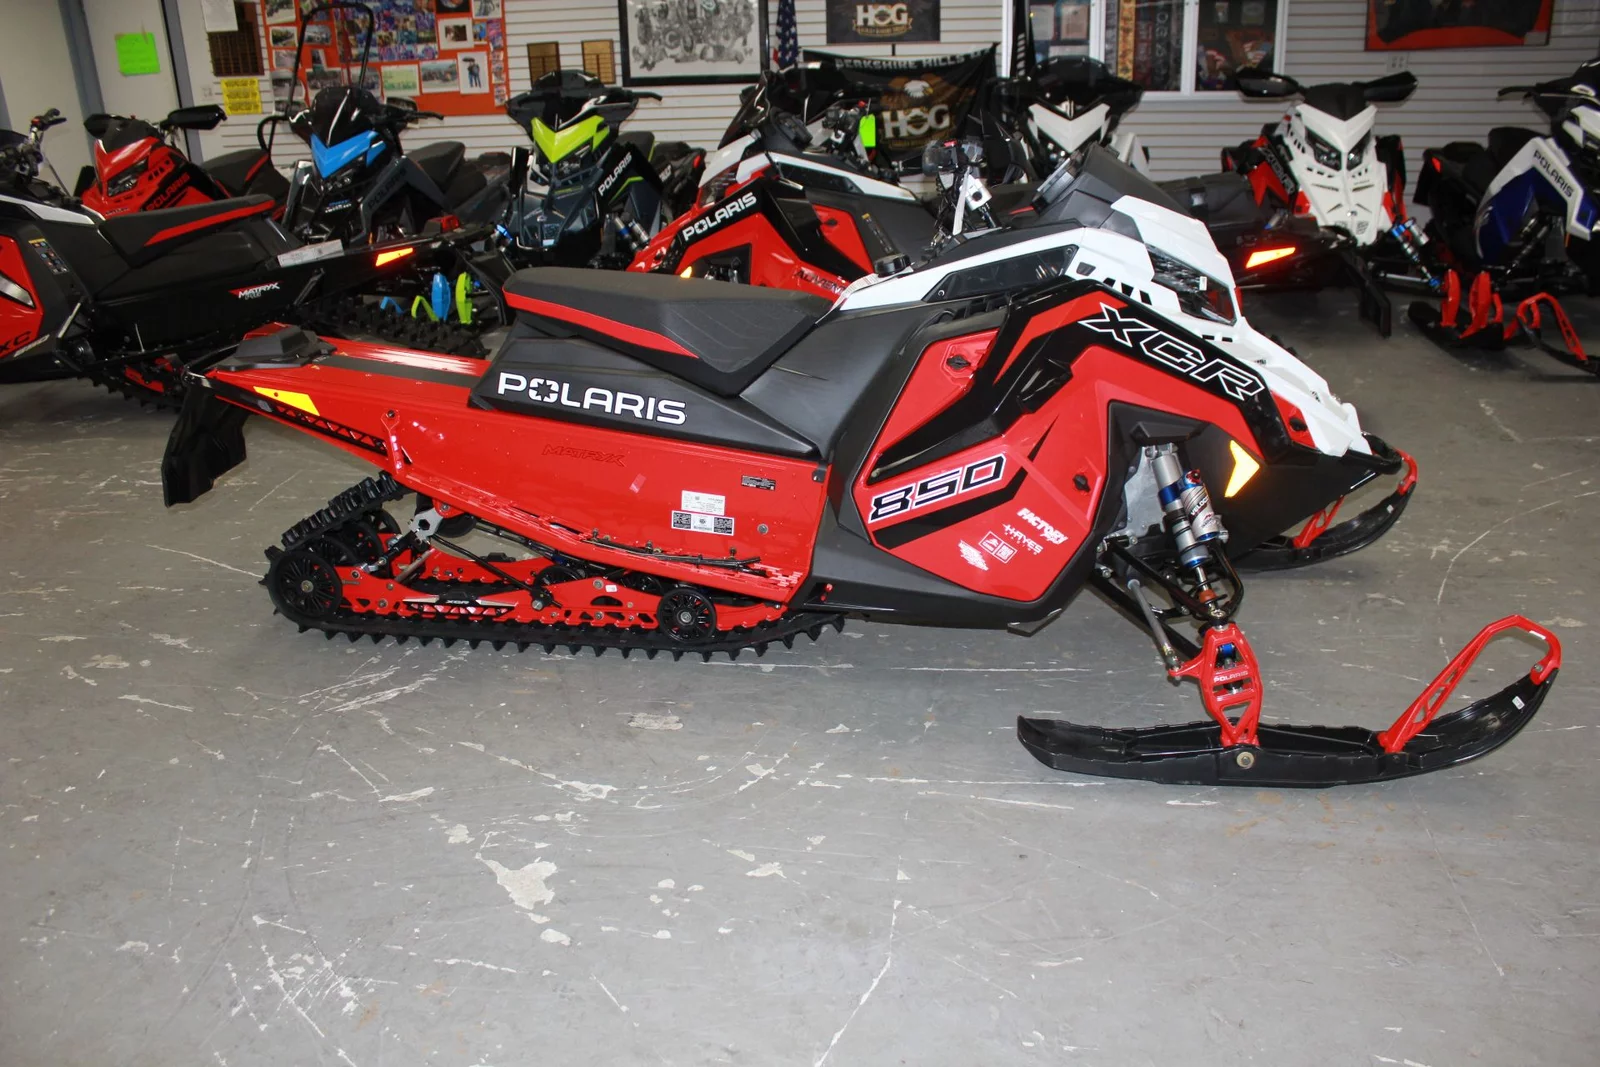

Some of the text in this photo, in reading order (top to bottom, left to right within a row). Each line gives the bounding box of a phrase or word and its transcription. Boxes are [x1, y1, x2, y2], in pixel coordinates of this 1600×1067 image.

[856, 3, 909, 26] HOG
[835, 55, 965, 70] BERKSHIRE HILLS
[882, 104, 951, 138] HOG
[145, 171, 190, 212] POLARIS
[598, 151, 633, 197] POLARIS
[1533, 149, 1575, 198] POLARIS
[682, 191, 758, 242] POLARIS
[238, 282, 280, 299] MATRYX
[1077, 301, 1266, 402] XCR
[497, 371, 687, 426] POLARIS
[541, 444, 626, 468] MATRYX
[868, 452, 1007, 524] 850
[1016, 507, 1068, 543] FACTORY
[1213, 670, 1249, 683] POLARIS
